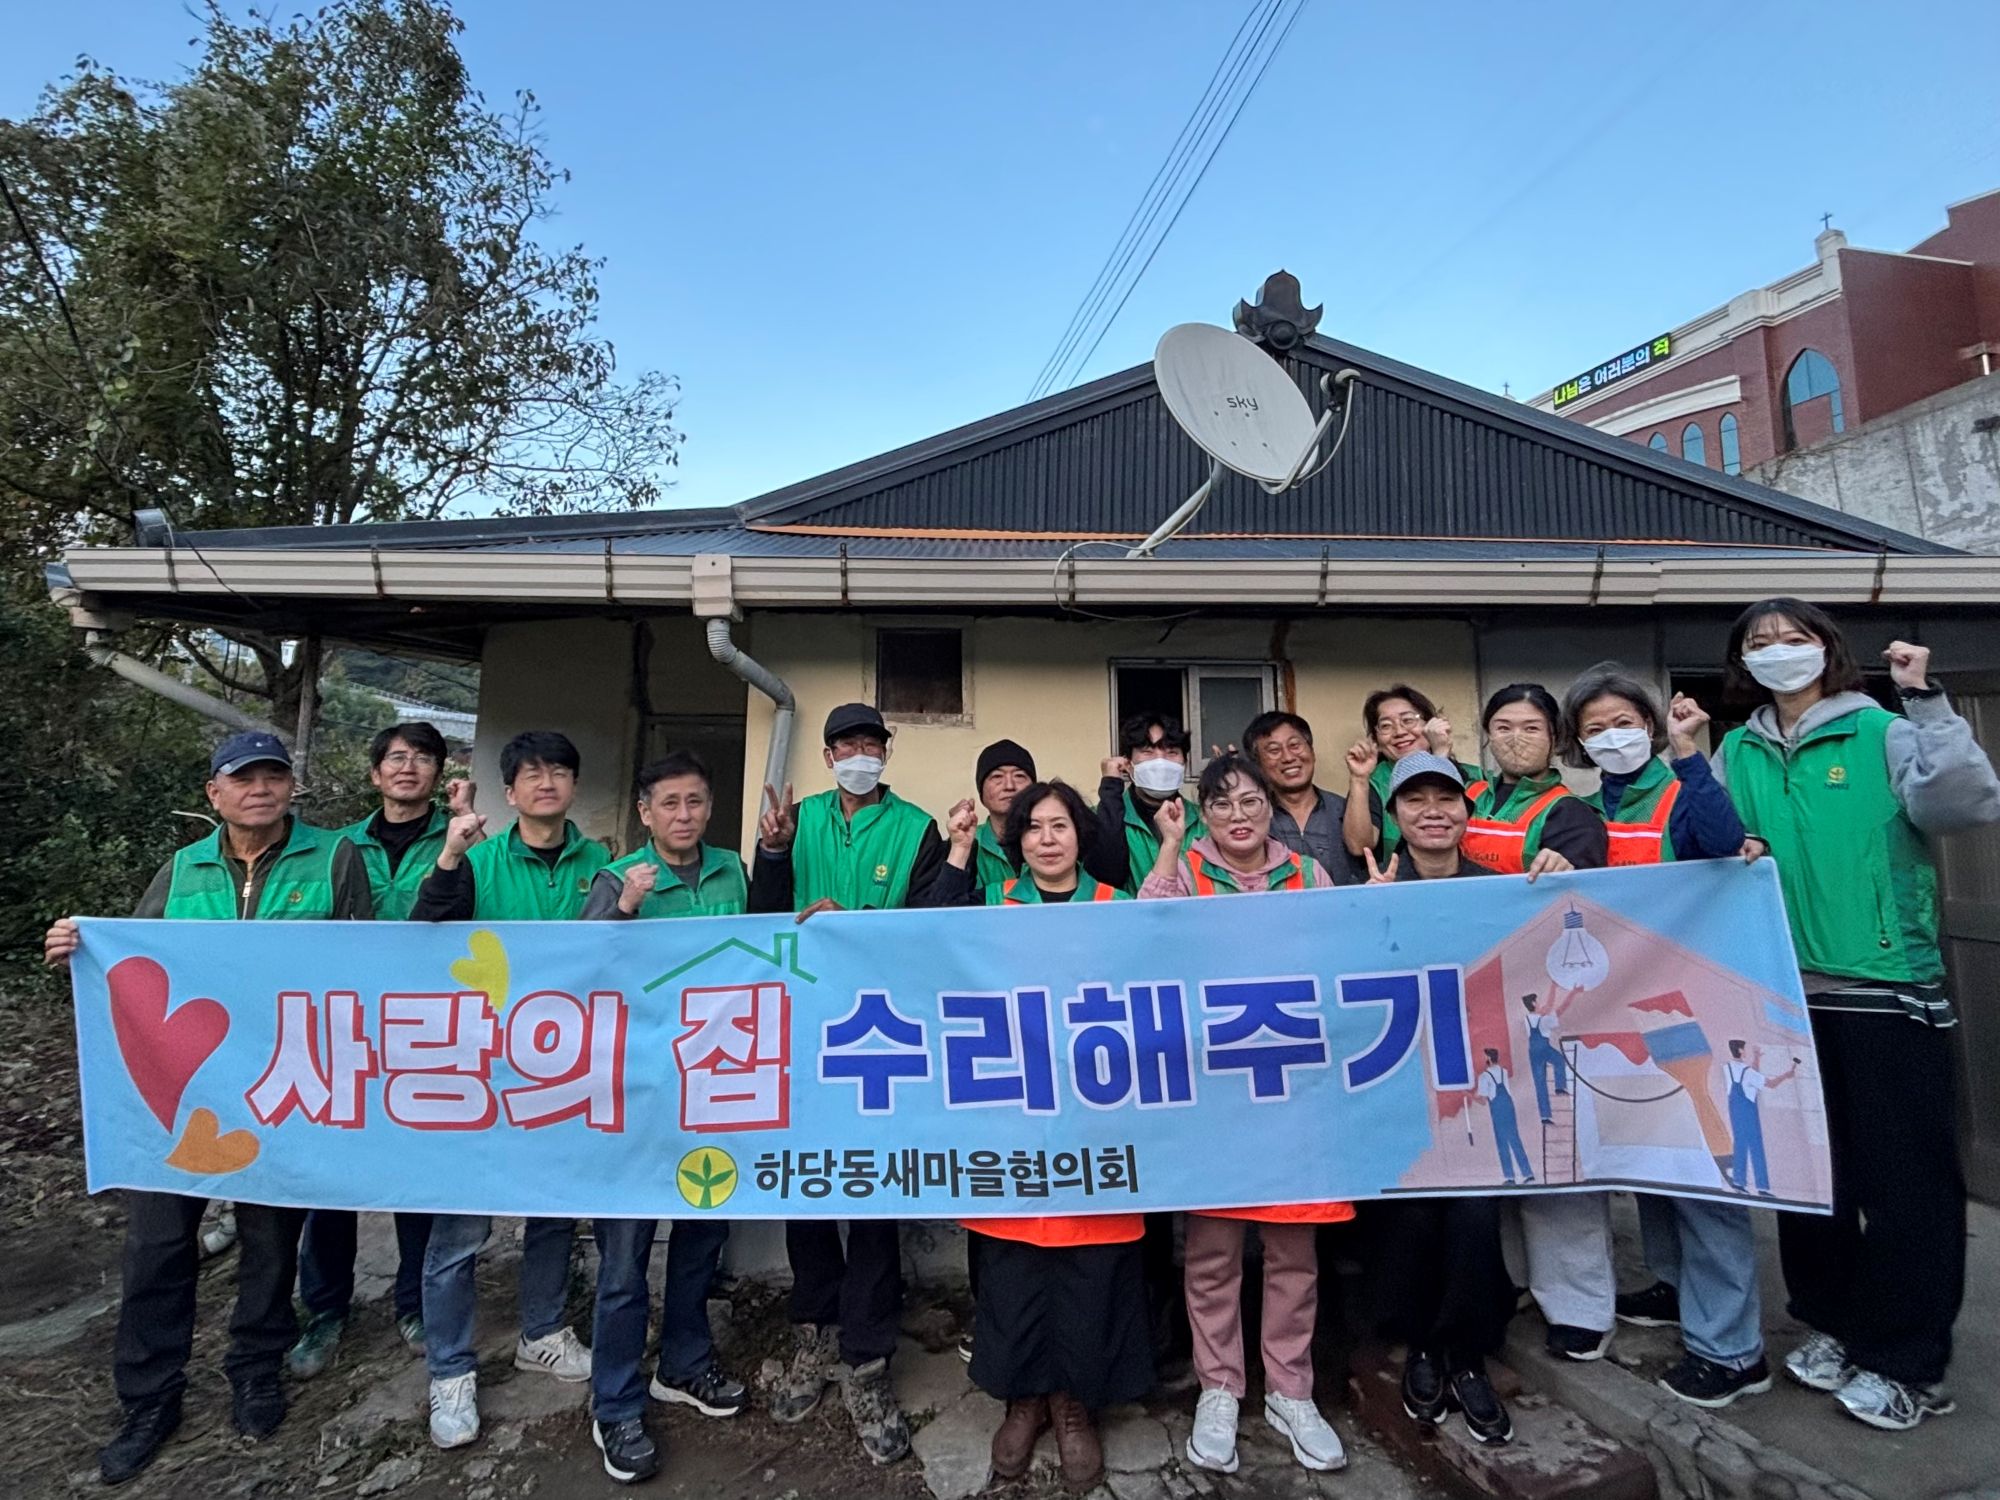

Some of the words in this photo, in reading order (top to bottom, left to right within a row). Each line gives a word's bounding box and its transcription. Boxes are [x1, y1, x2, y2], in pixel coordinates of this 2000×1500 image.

[1594, 346, 1650, 385] 여러분의
[1226, 395, 1259, 411] sky
[245, 990, 629, 1131] 사랑의
[673, 982, 792, 1132] 집
[818, 964, 1474, 1116] 수리해주기
[753, 1144, 1139, 1199] 하당동새마을협의회
